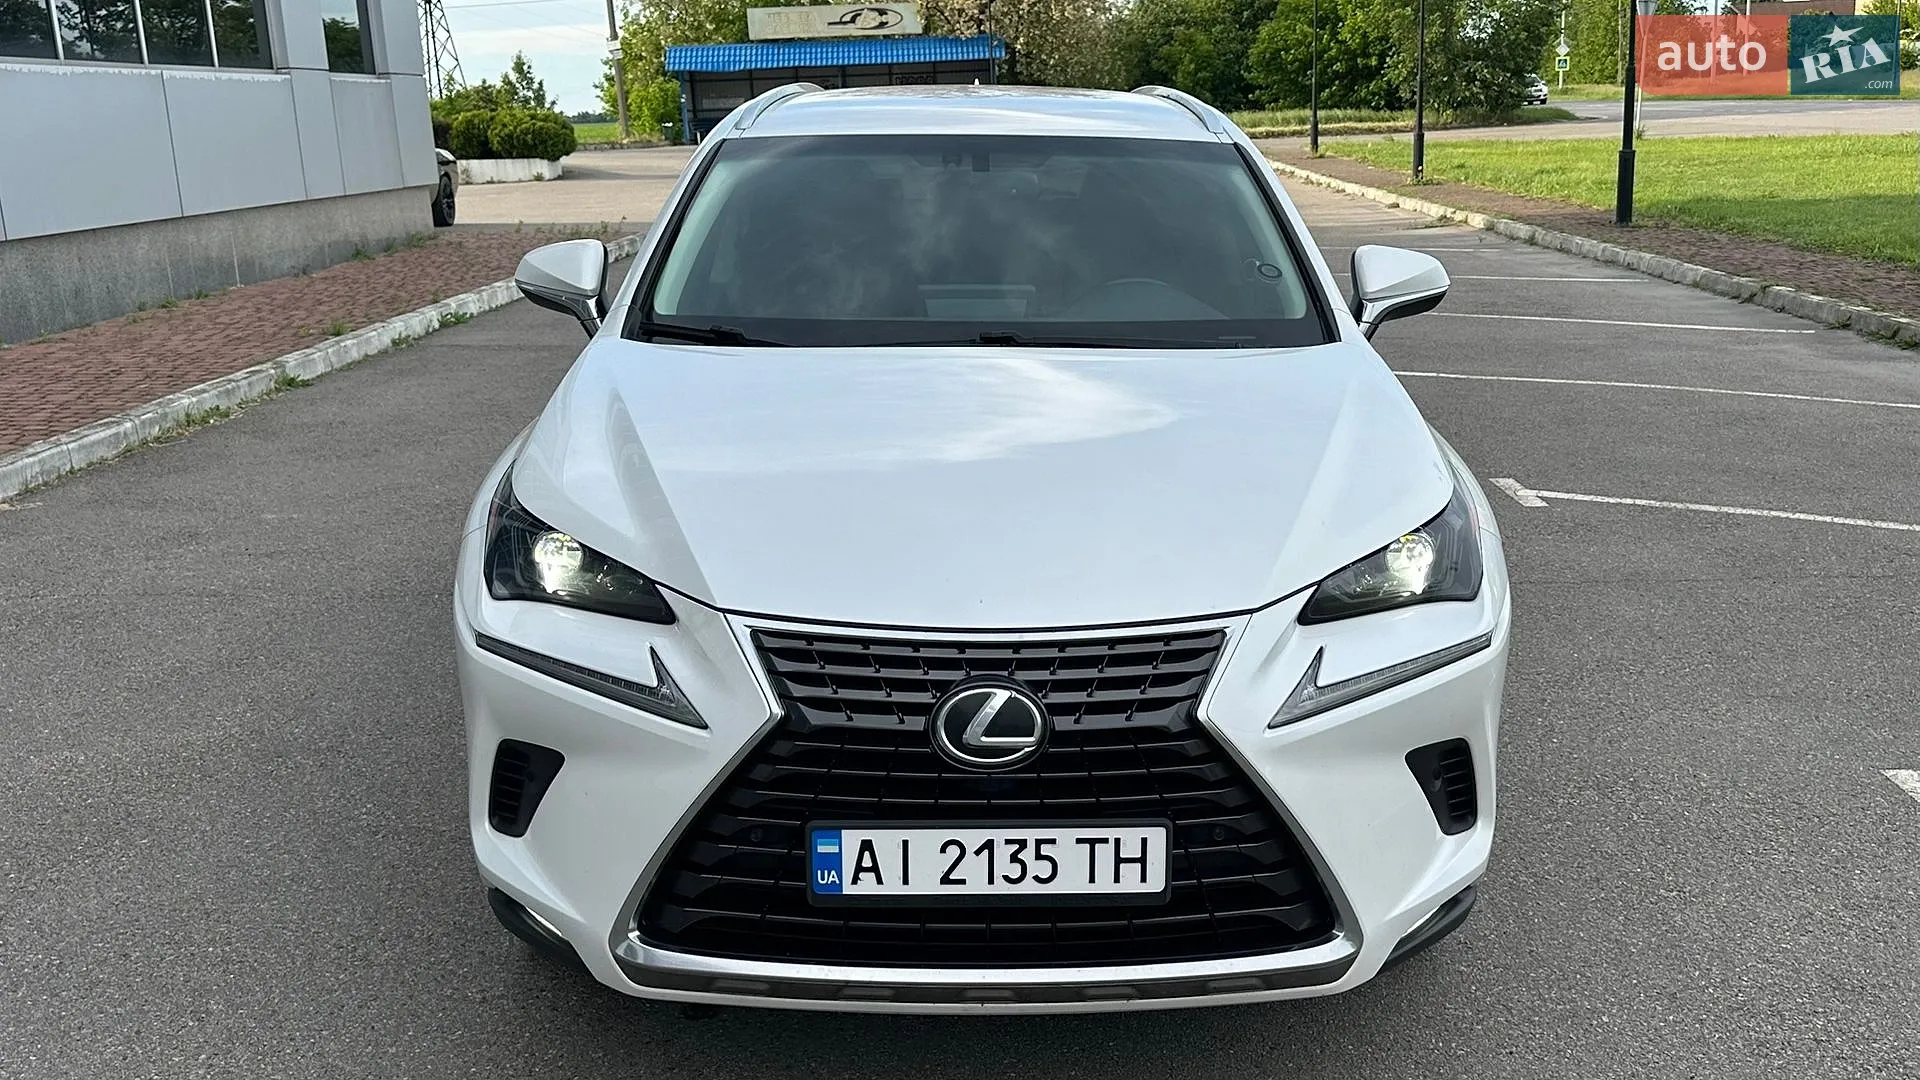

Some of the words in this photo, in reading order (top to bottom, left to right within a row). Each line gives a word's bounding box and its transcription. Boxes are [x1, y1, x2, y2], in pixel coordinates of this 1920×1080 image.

[939, 838, 1059, 885] 2135
[1075, 837, 1148, 884] TH
[817, 870, 840, 884] UA
